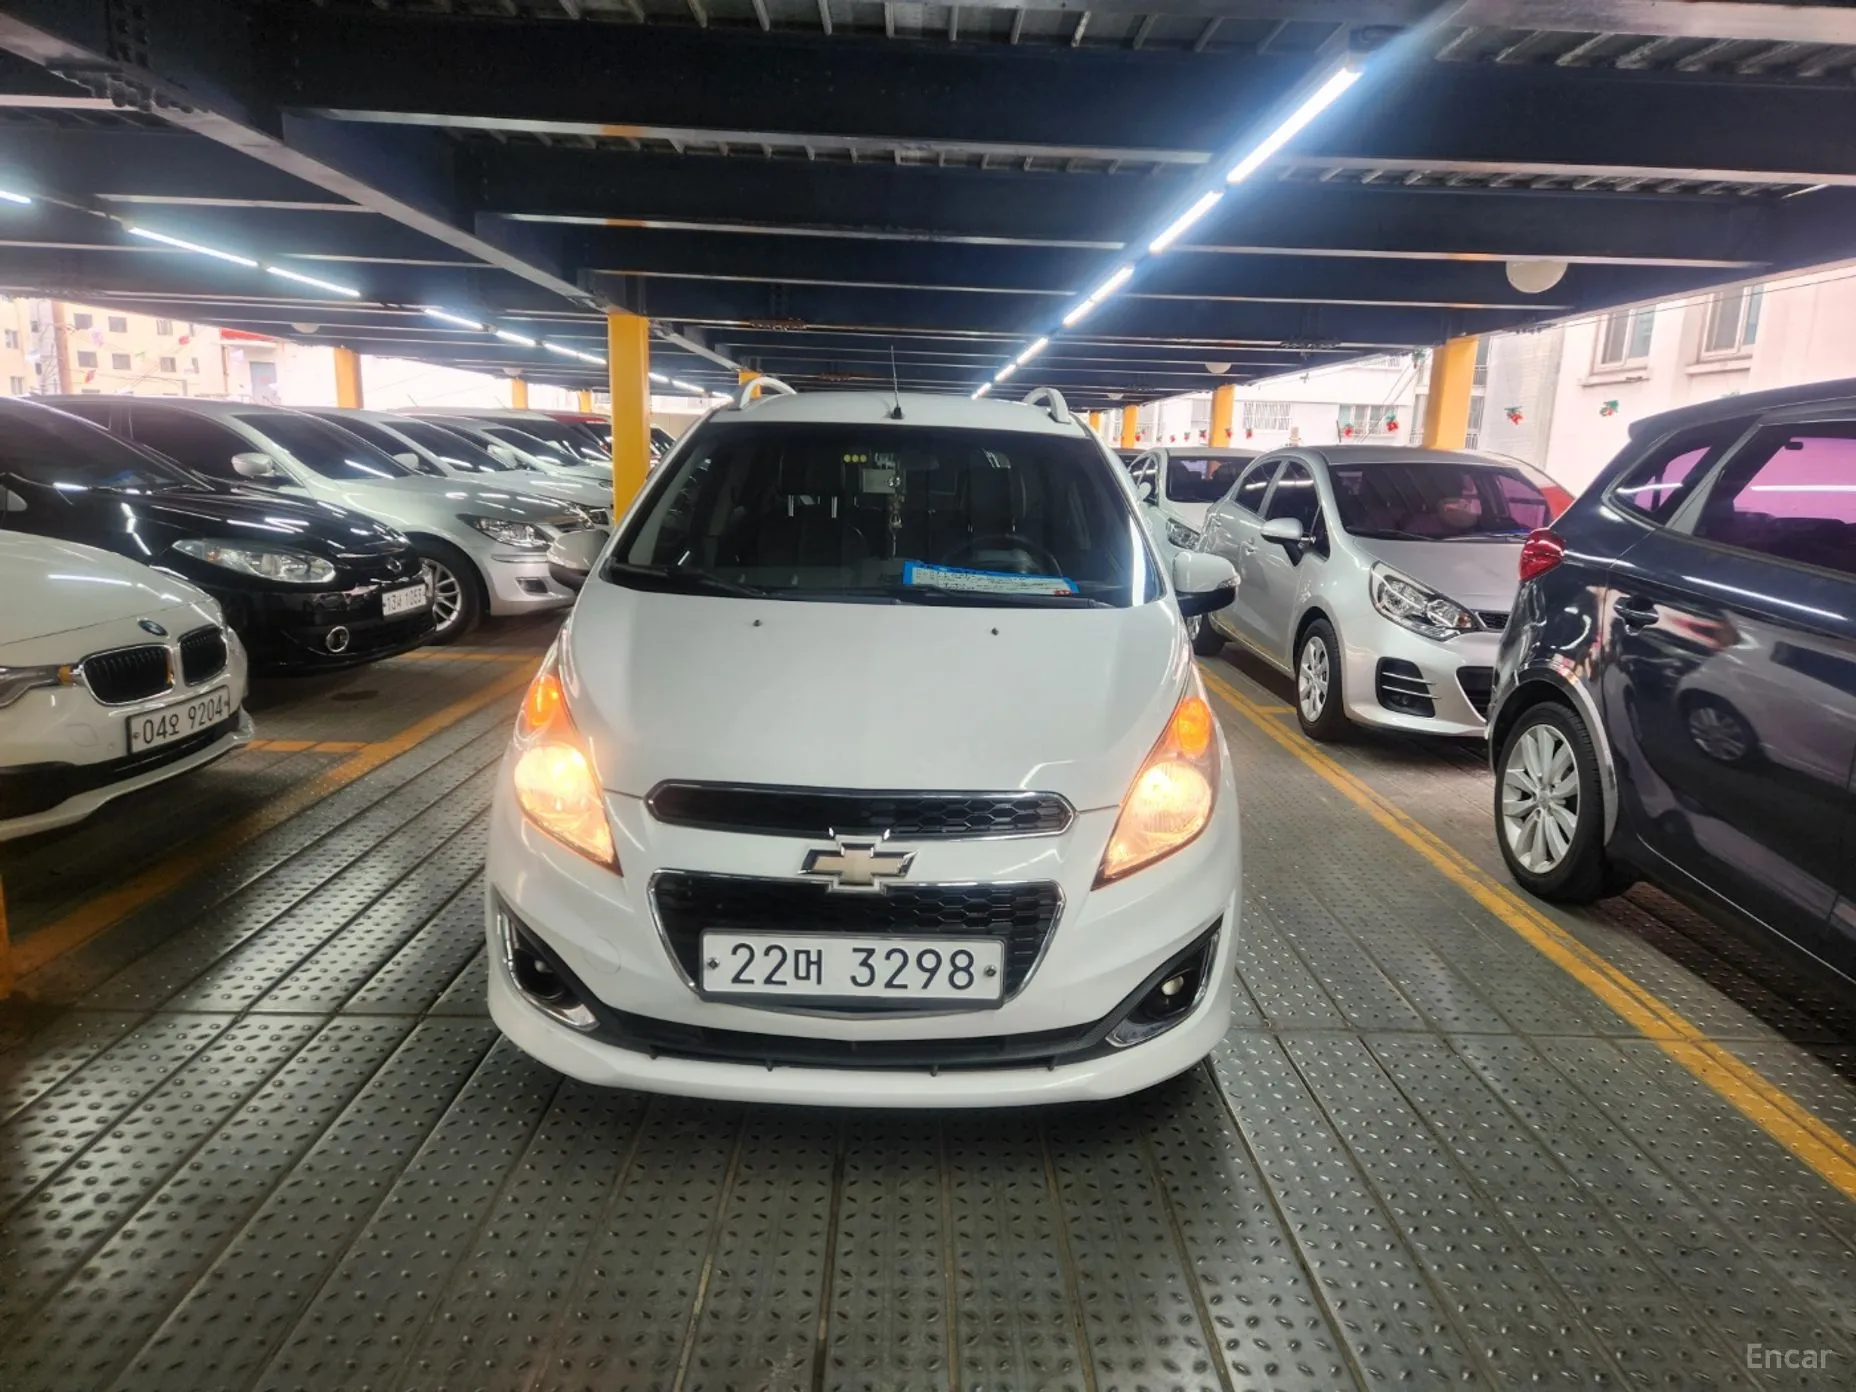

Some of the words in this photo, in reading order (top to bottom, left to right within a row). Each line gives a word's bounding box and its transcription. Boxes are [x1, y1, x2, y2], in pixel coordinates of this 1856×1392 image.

[143, 714, 179, 743] 04오
[188, 695, 222, 729] 9204
[731, 943, 822, 985] 22머
[850, 948, 974, 990] 3298
